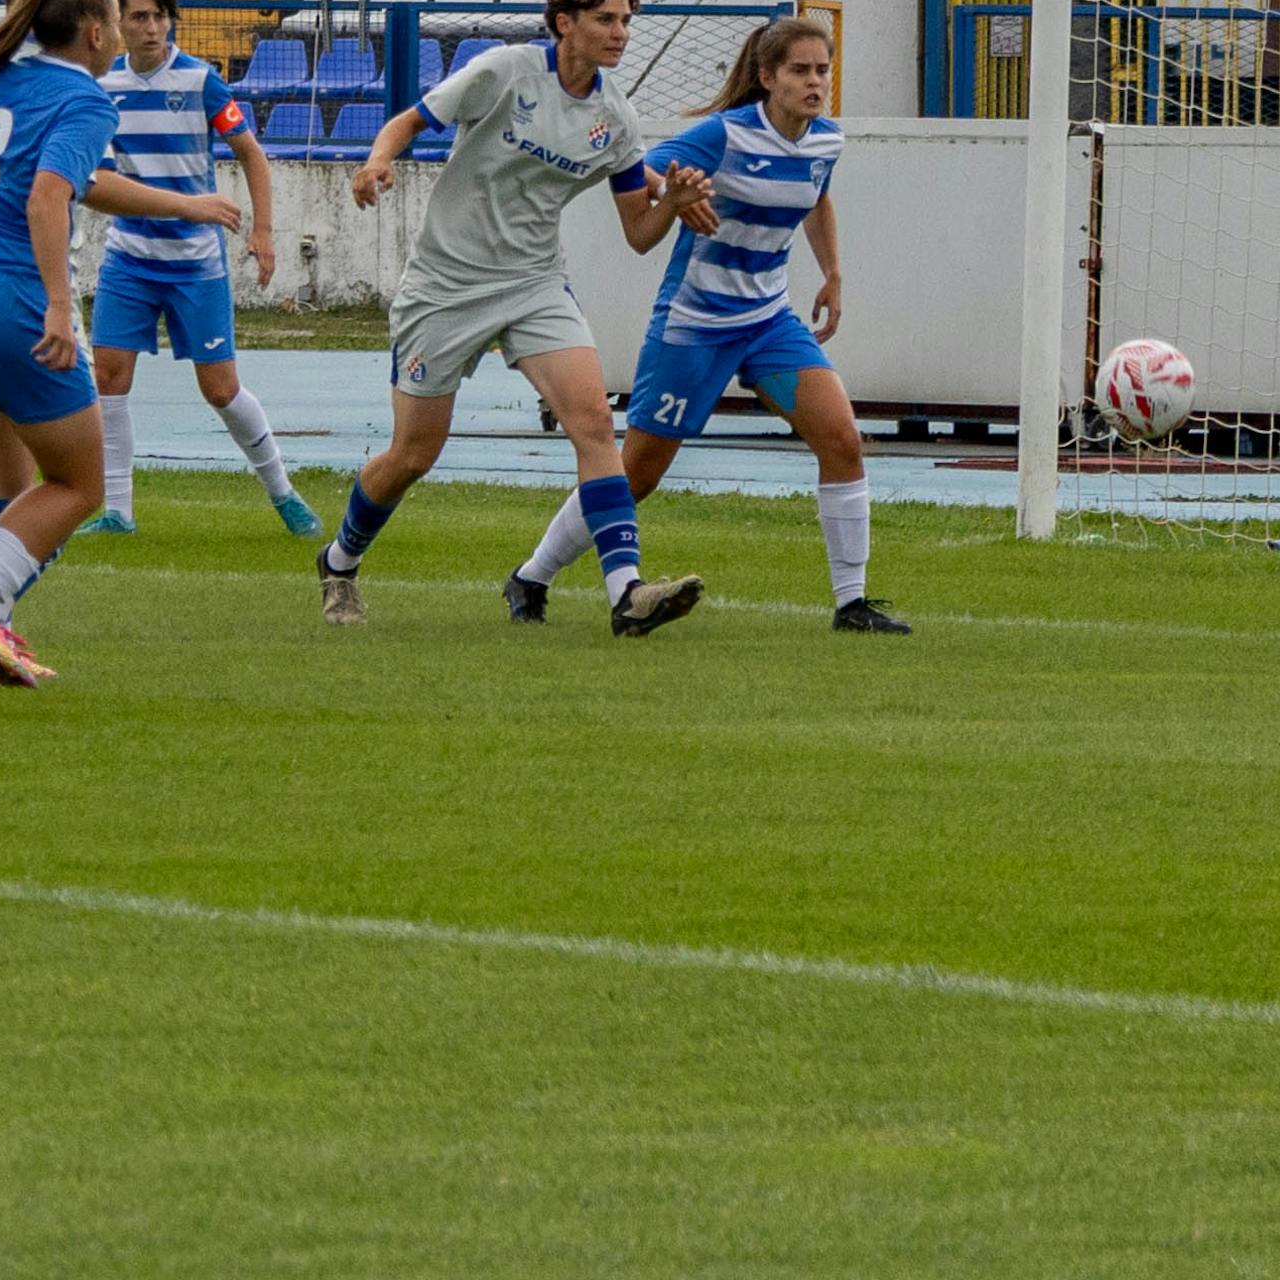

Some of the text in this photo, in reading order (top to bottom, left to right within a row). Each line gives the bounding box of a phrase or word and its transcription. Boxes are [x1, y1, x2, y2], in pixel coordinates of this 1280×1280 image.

[226, 107, 240, 122] C
[518, 139, 590, 176] FAVBET
[654, 393, 688, 427] 21
